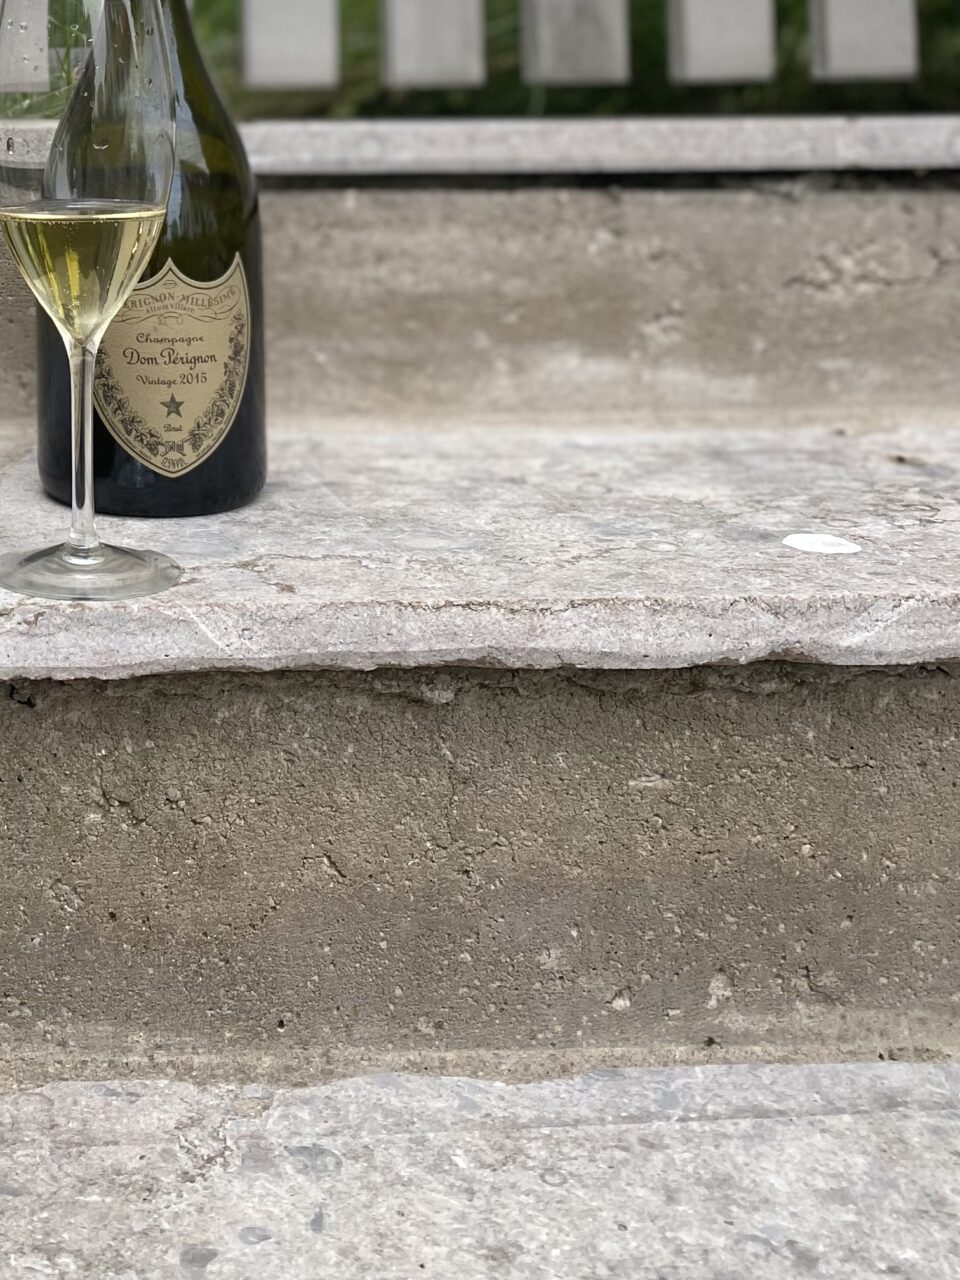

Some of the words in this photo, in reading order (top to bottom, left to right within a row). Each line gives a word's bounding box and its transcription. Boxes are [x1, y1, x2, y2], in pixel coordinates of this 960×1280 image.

[136, 332, 205, 347] Champagne
[122, 347, 159, 366] Dom
[160, 347, 217, 371] Pérignon
[136, 374, 178, 389] Vintage
[179, 372, 208, 385] 2015
